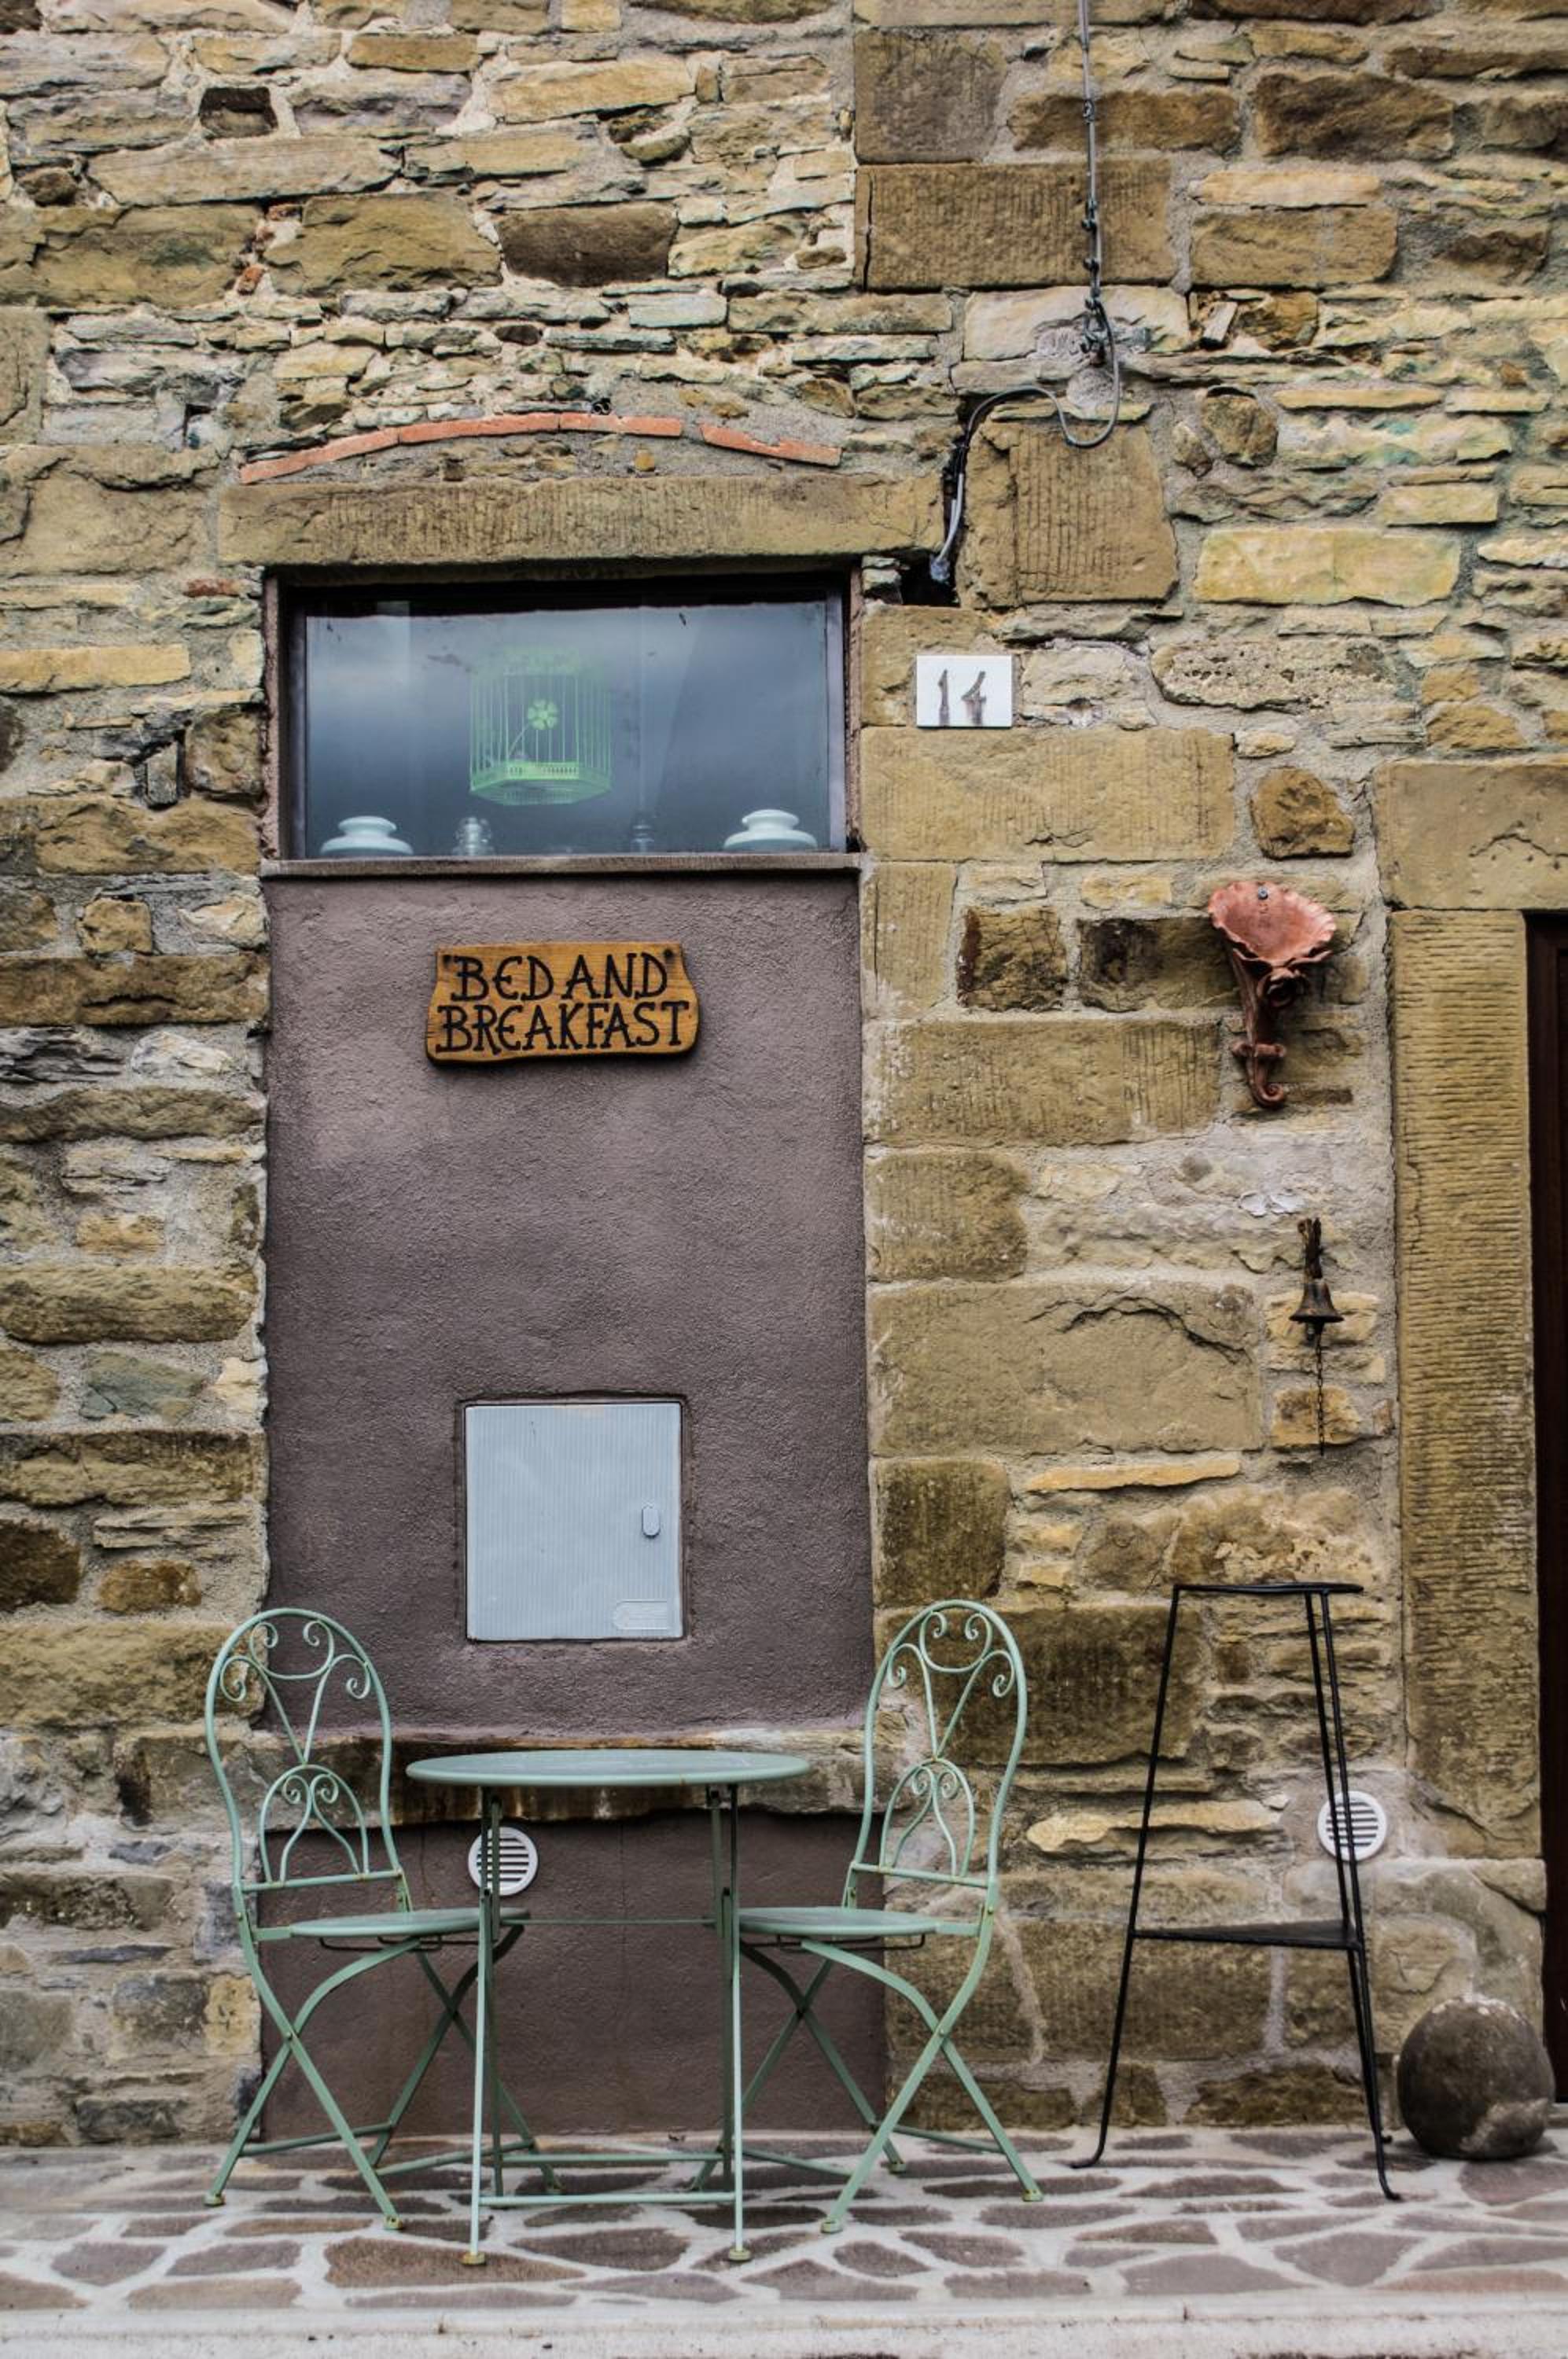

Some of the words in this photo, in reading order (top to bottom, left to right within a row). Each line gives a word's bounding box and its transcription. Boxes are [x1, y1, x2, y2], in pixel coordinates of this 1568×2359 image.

[937, 669, 987, 727] 14
[451, 955, 554, 1002] BED
[561, 952, 668, 999] AND
[436, 1000, 690, 1054] BREAKFAST
